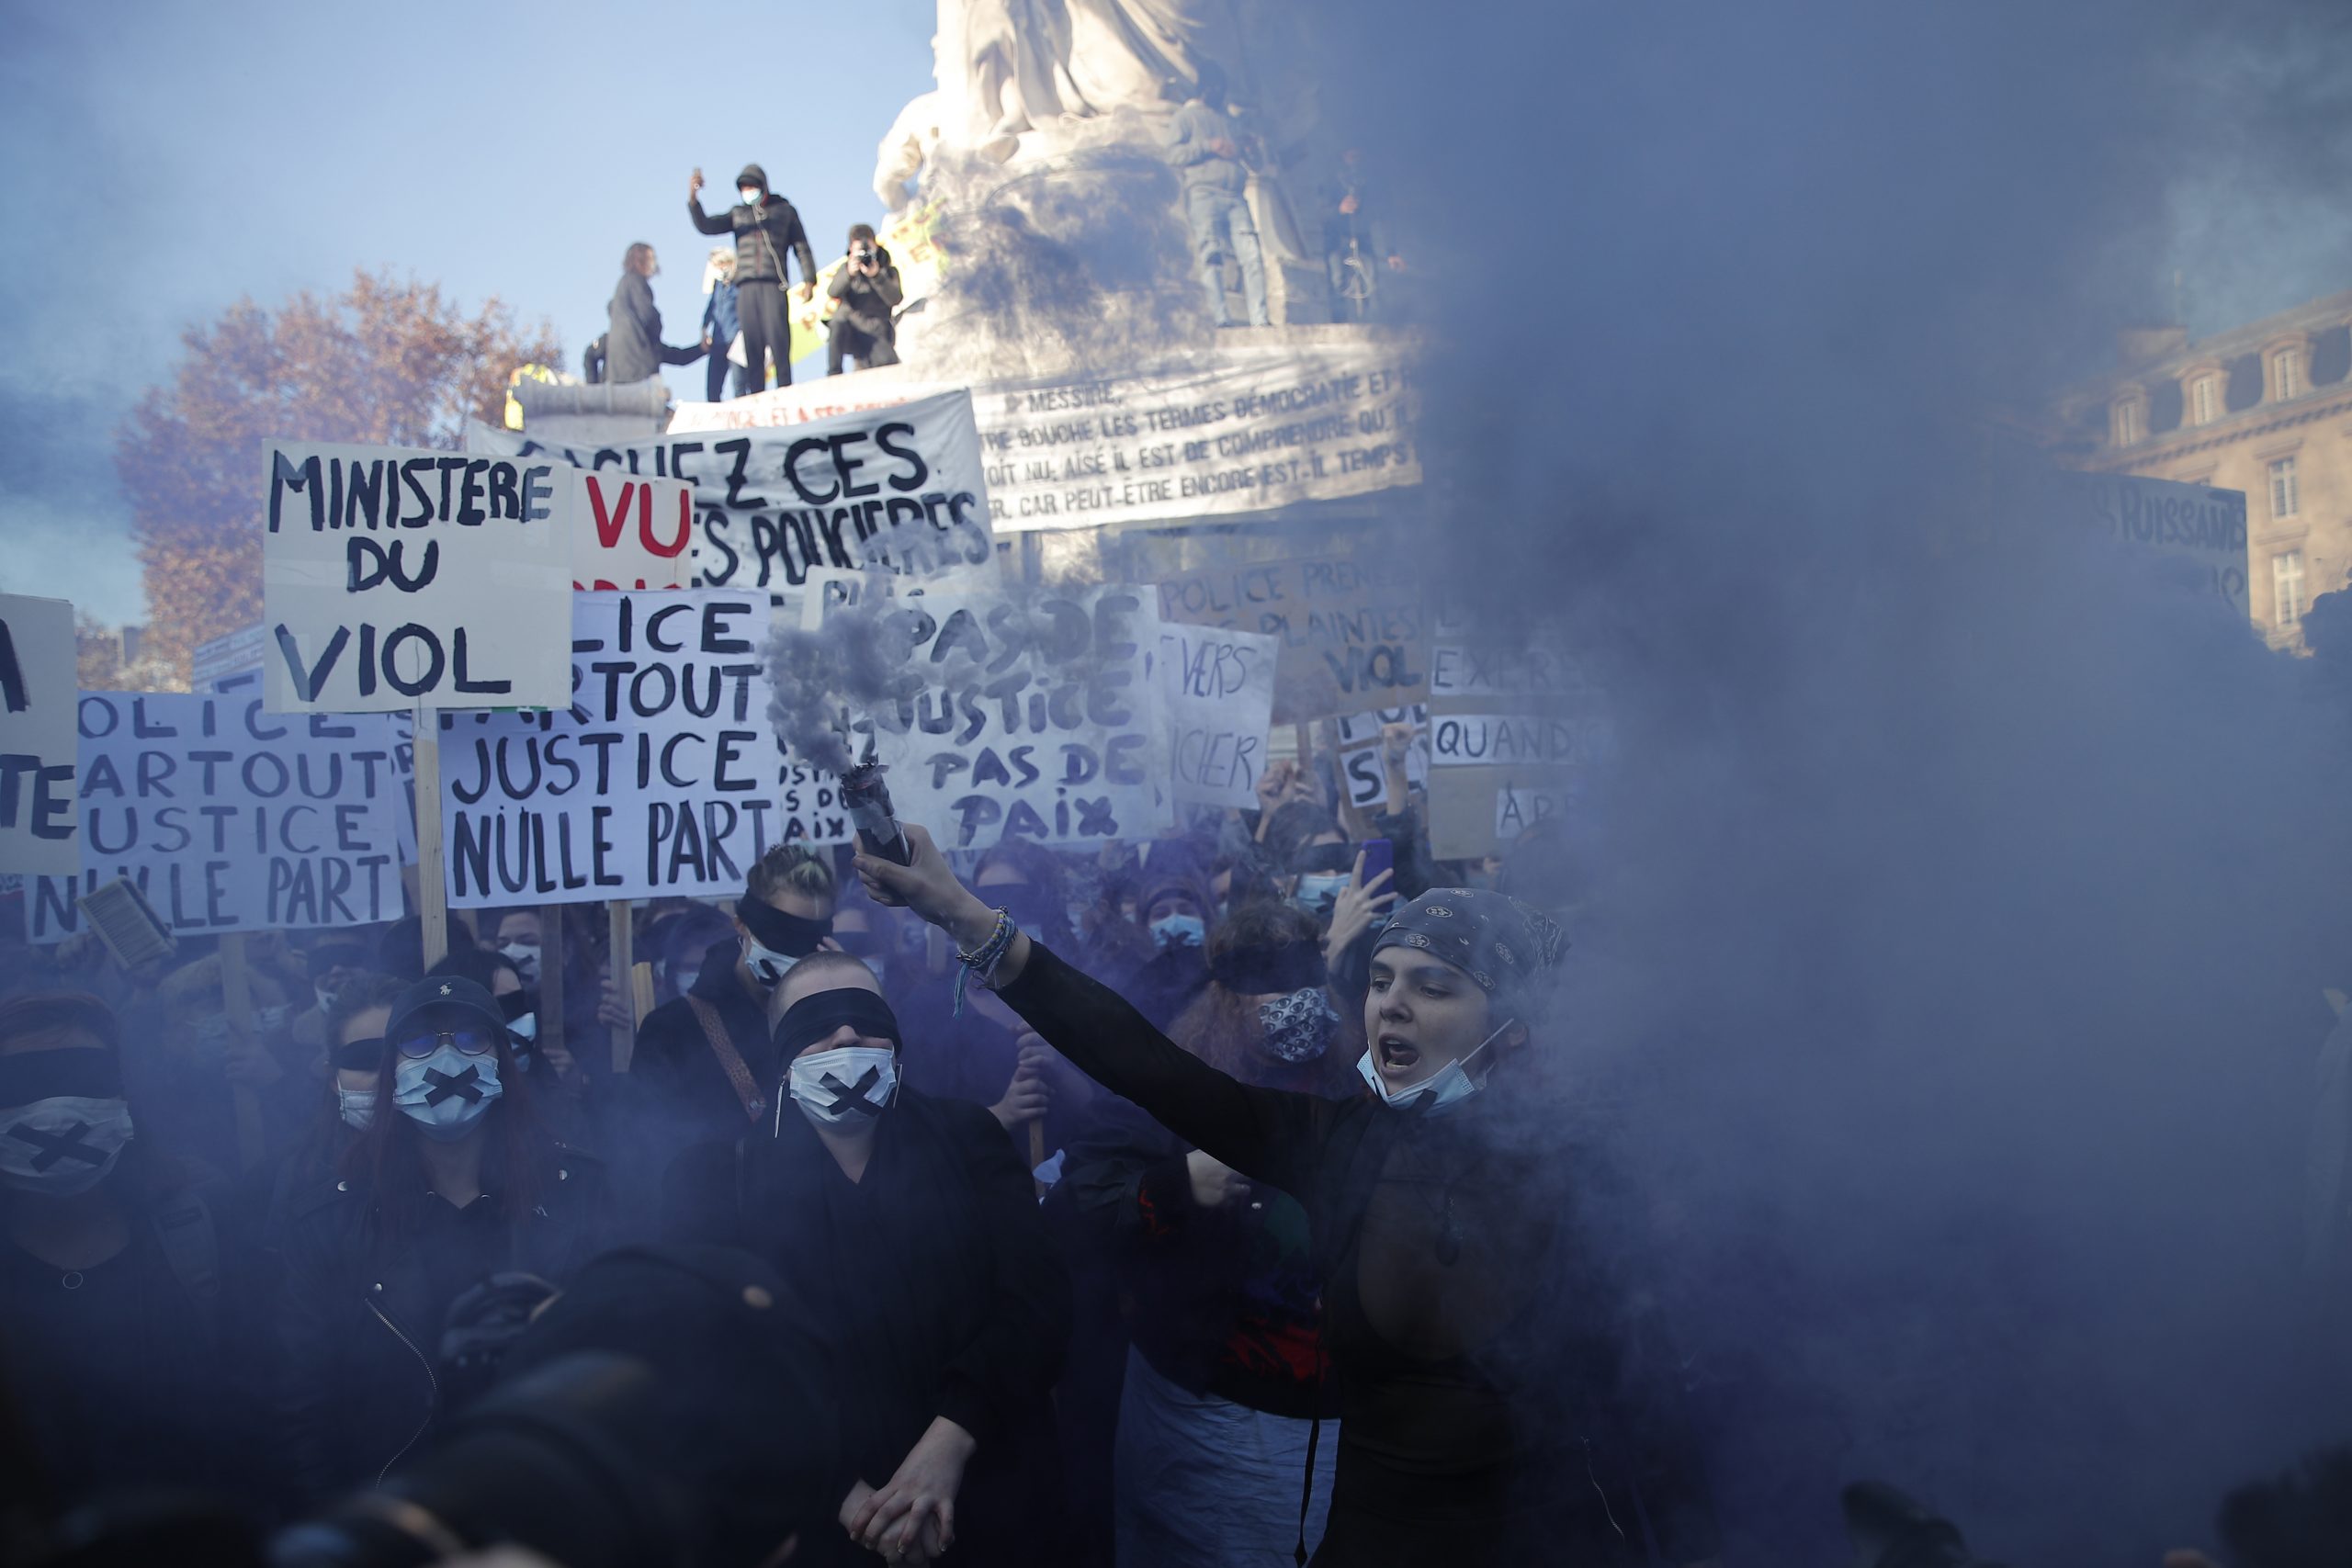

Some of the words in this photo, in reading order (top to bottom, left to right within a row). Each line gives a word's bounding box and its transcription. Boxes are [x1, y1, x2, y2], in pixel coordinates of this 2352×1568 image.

[1018, 421, 1094, 447] BOUCHE
[1101, 415, 1138, 438] LES
[1145, 402, 1227, 432] TERMES
[1368, 370, 1391, 395] ET
[1138, 445, 1176, 469] EST
[1184, 441, 1210, 463] DE
[1216, 414, 1351, 457] COMPRENDRE
[267, 448, 553, 534] MINISTERE
[784, 423, 929, 505] CES
[1019, 493, 1058, 516] CAR
[1180, 467, 1256, 498] ENCORE
[1336, 443, 1408, 474] TEMPS
[584, 474, 689, 558] VU
[345, 535, 440, 594] DU
[1159, 568, 1284, 618] POLICE
[571, 595, 759, 653] ICE
[878, 603, 1024, 675] PAS
[1040, 595, 1140, 667] DE
[274, 623, 512, 704] VIOL
[1323, 644, 1424, 694] VIOL
[77, 695, 356, 739] OLICE
[1436, 720, 1575, 762] QUAND
[77, 751, 389, 800] ARTOUT
[450, 728, 760, 805] JUSTICE
[924, 745, 1041, 790] PAS
[1057, 734, 1147, 786] DE
[89, 806, 374, 854] USTICE
[648, 798, 799, 888] PART
[267, 852, 392, 925] PART
